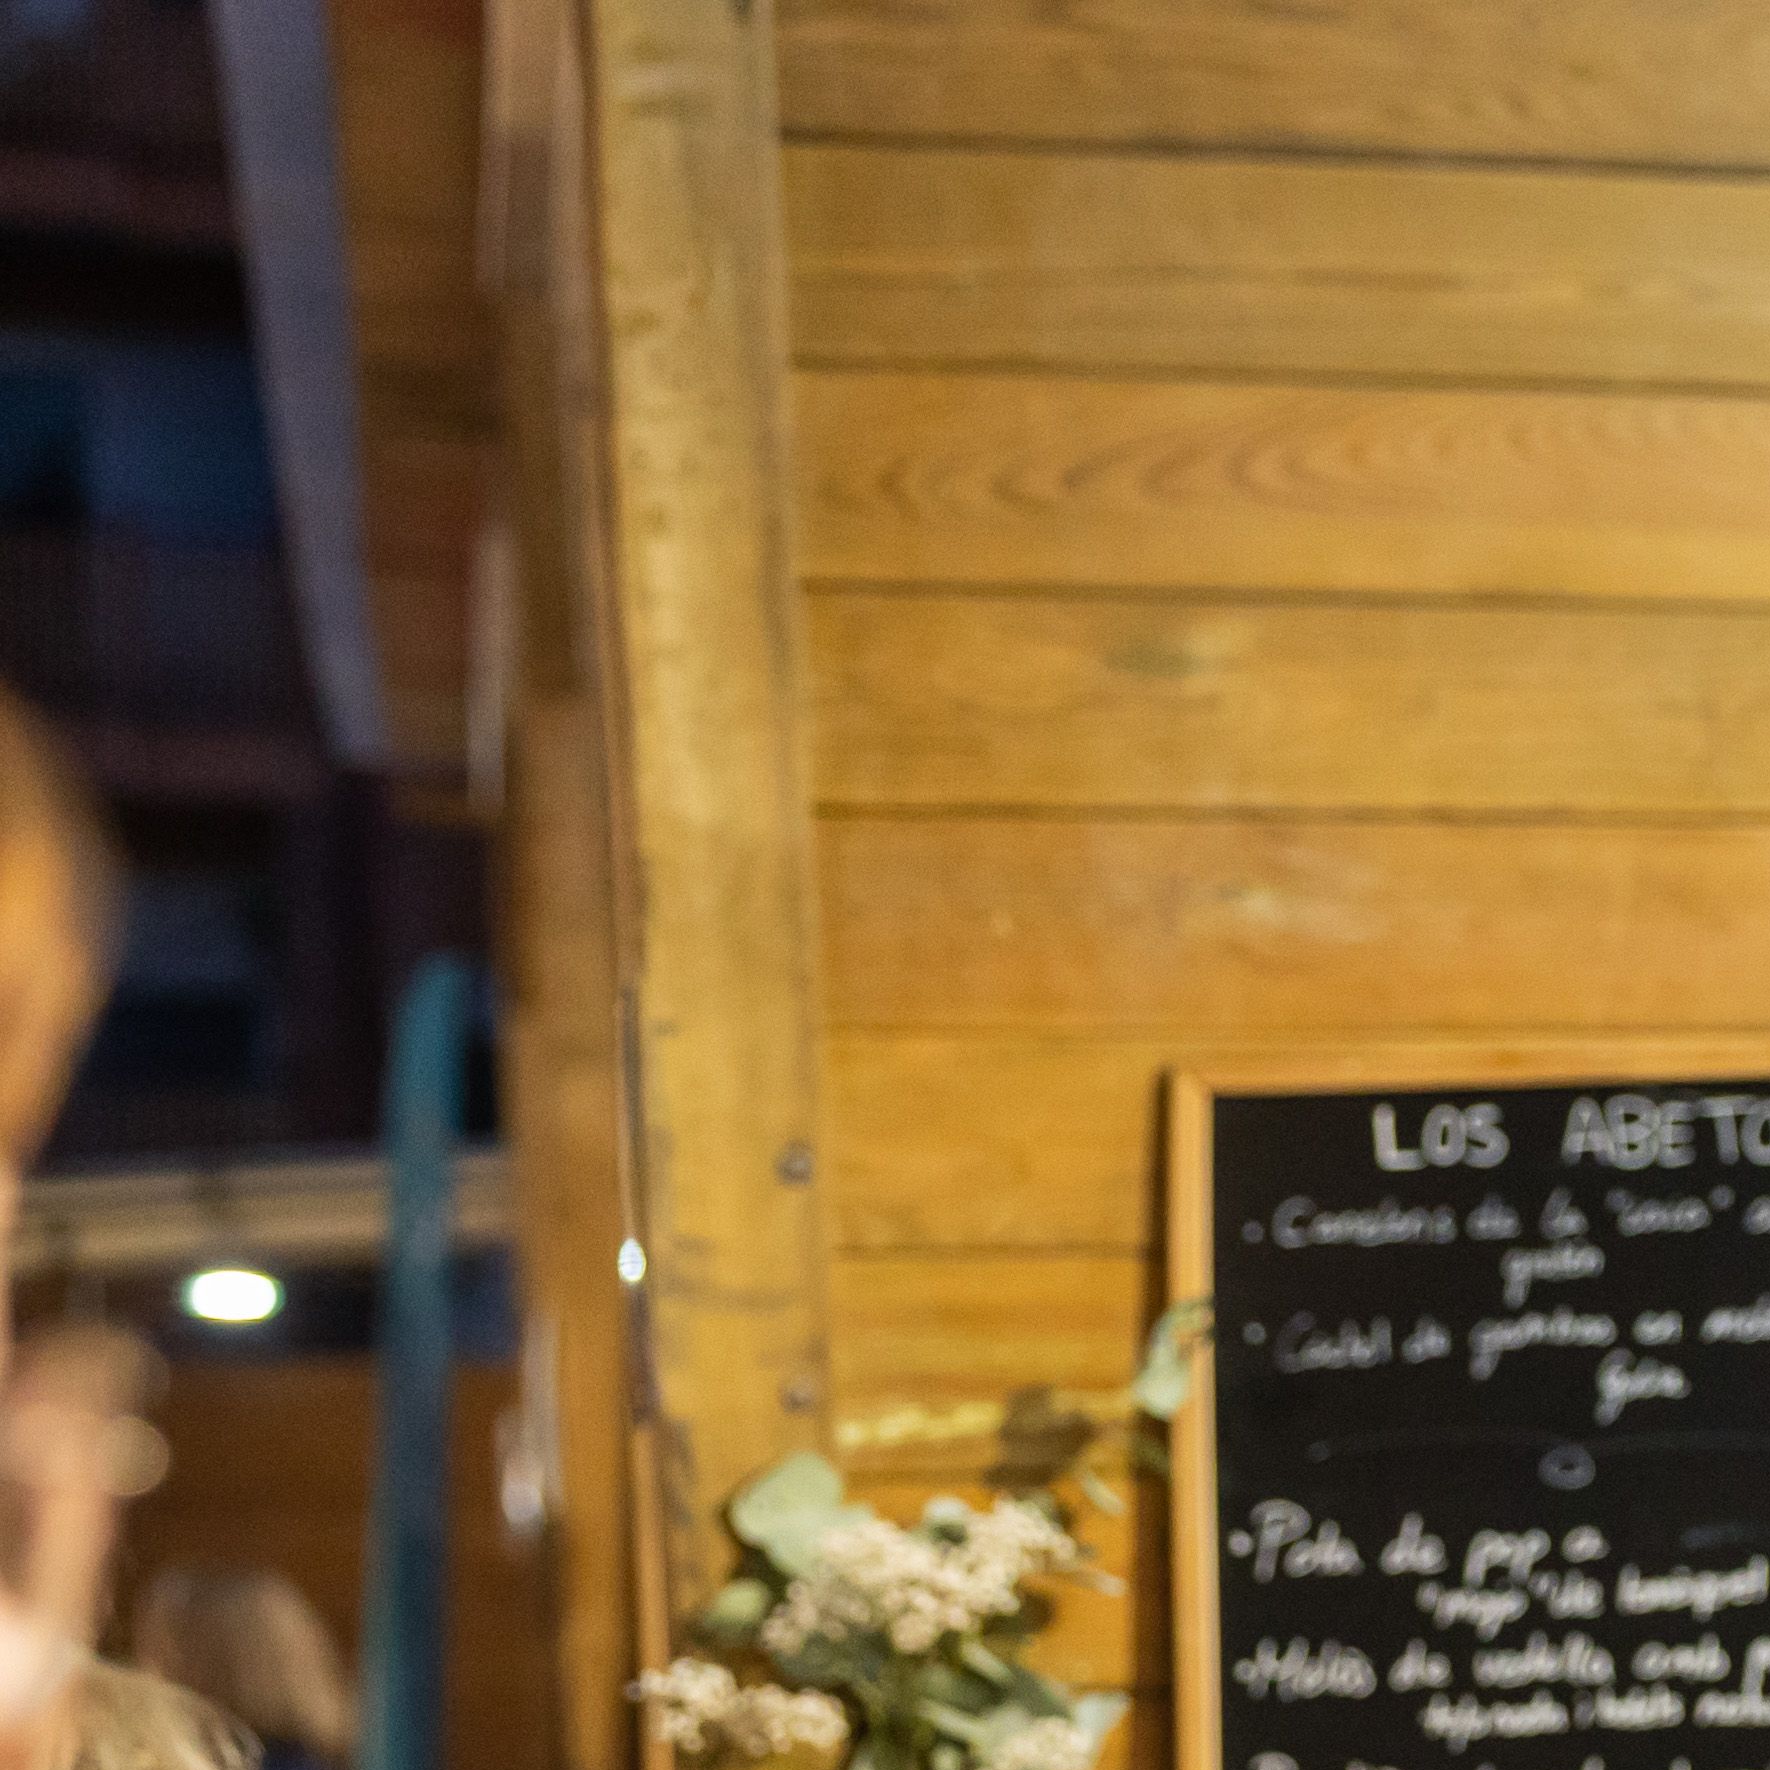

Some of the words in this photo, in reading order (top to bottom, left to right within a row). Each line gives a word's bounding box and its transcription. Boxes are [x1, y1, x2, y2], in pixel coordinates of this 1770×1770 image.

[1372, 1103, 1510, 1170] LOS
[1466, 1195, 1522, 1241] de
[1541, 1187, 1588, 1240] la
[1401, 1315, 1452, 1363] de
[1633, 1311, 1682, 1345] en
[1250, 1499, 1363, 1583] Pota
[1380, 1512, 1447, 1574] de
[1464, 1528, 1550, 1587] pop
[1550, 1570, 1604, 1618] de
[1388, 1639, 1452, 1691] de
[1472, 1631, 1616, 1688] vedella
[1633, 1633, 1730, 1681] amb
